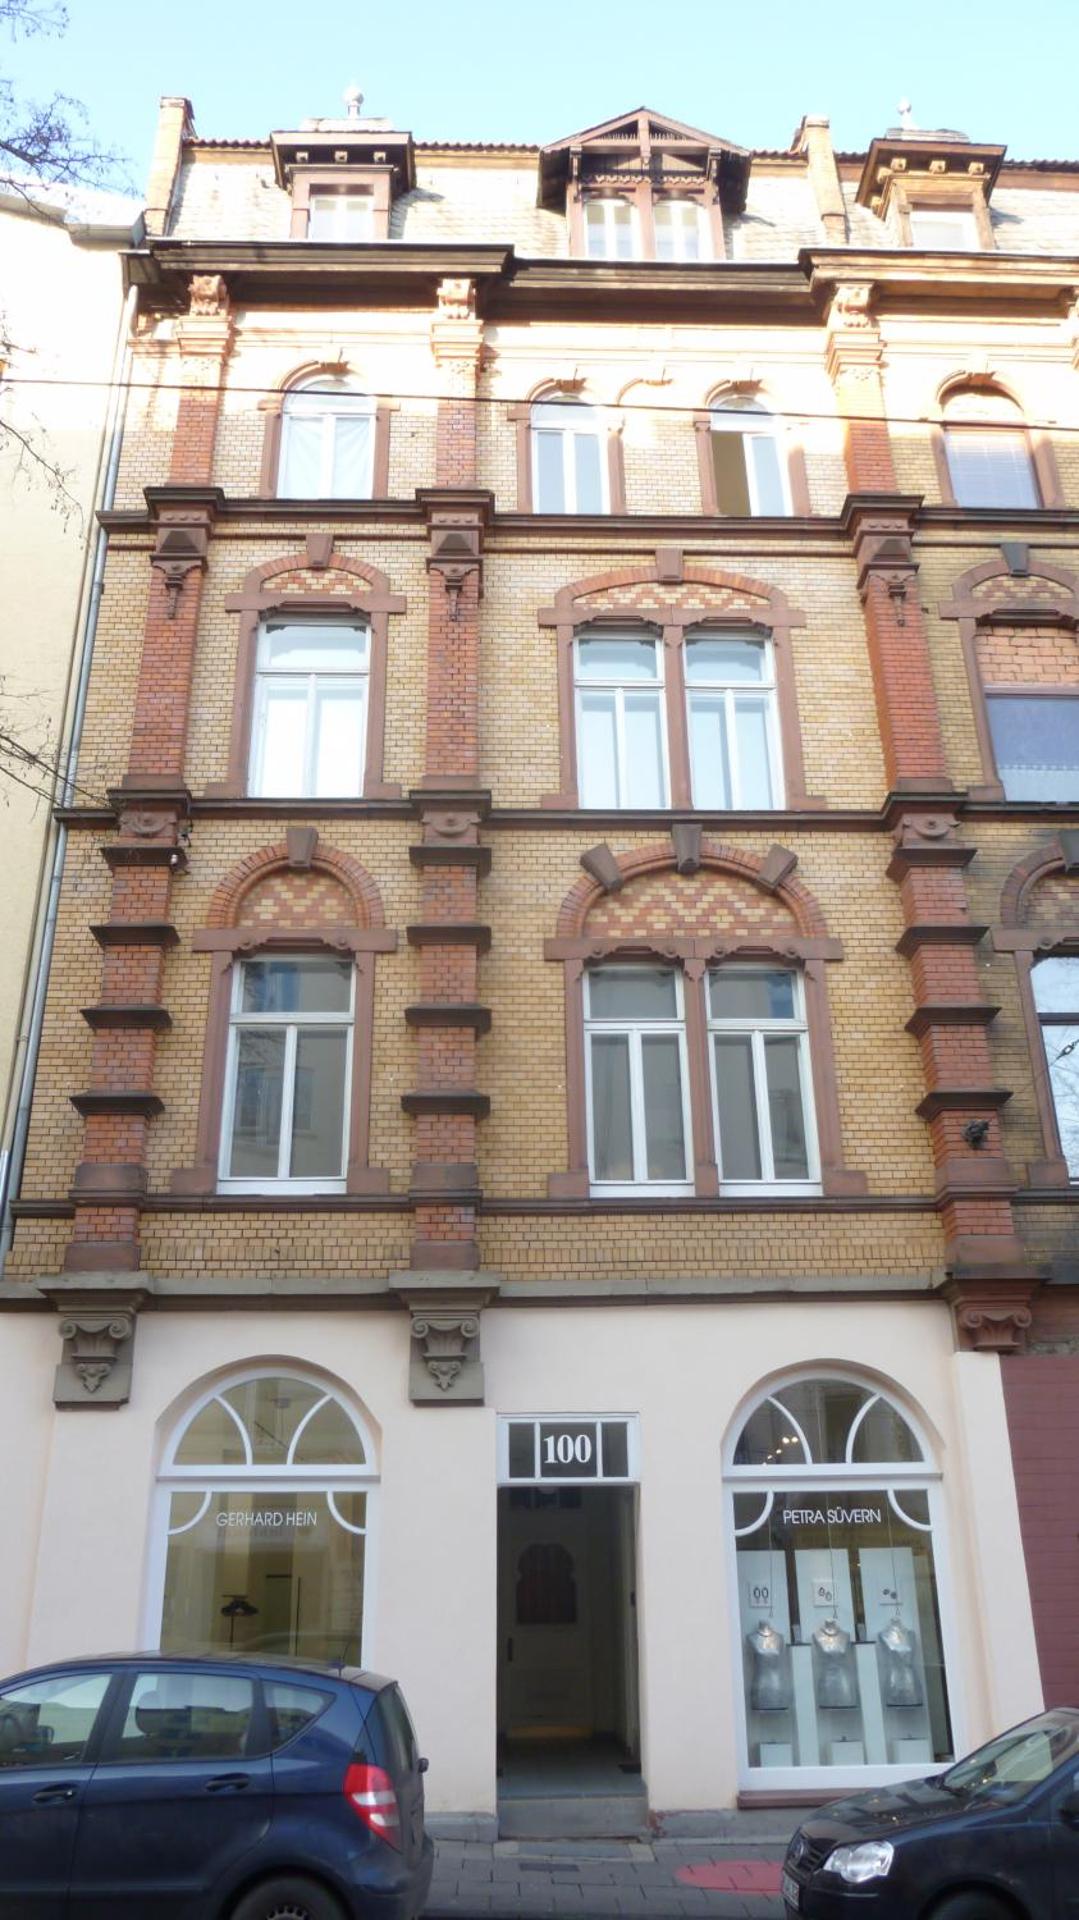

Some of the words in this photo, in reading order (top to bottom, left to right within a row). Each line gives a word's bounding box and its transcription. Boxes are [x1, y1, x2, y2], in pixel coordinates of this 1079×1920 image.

[543, 1434, 592, 1464] 100
[216, 1512, 282, 1527] GERHARD
[286, 1511, 317, 1526] HEIN
[783, 1509, 825, 1526] PETRA
[826, 1506, 881, 1523] SÜVERN
